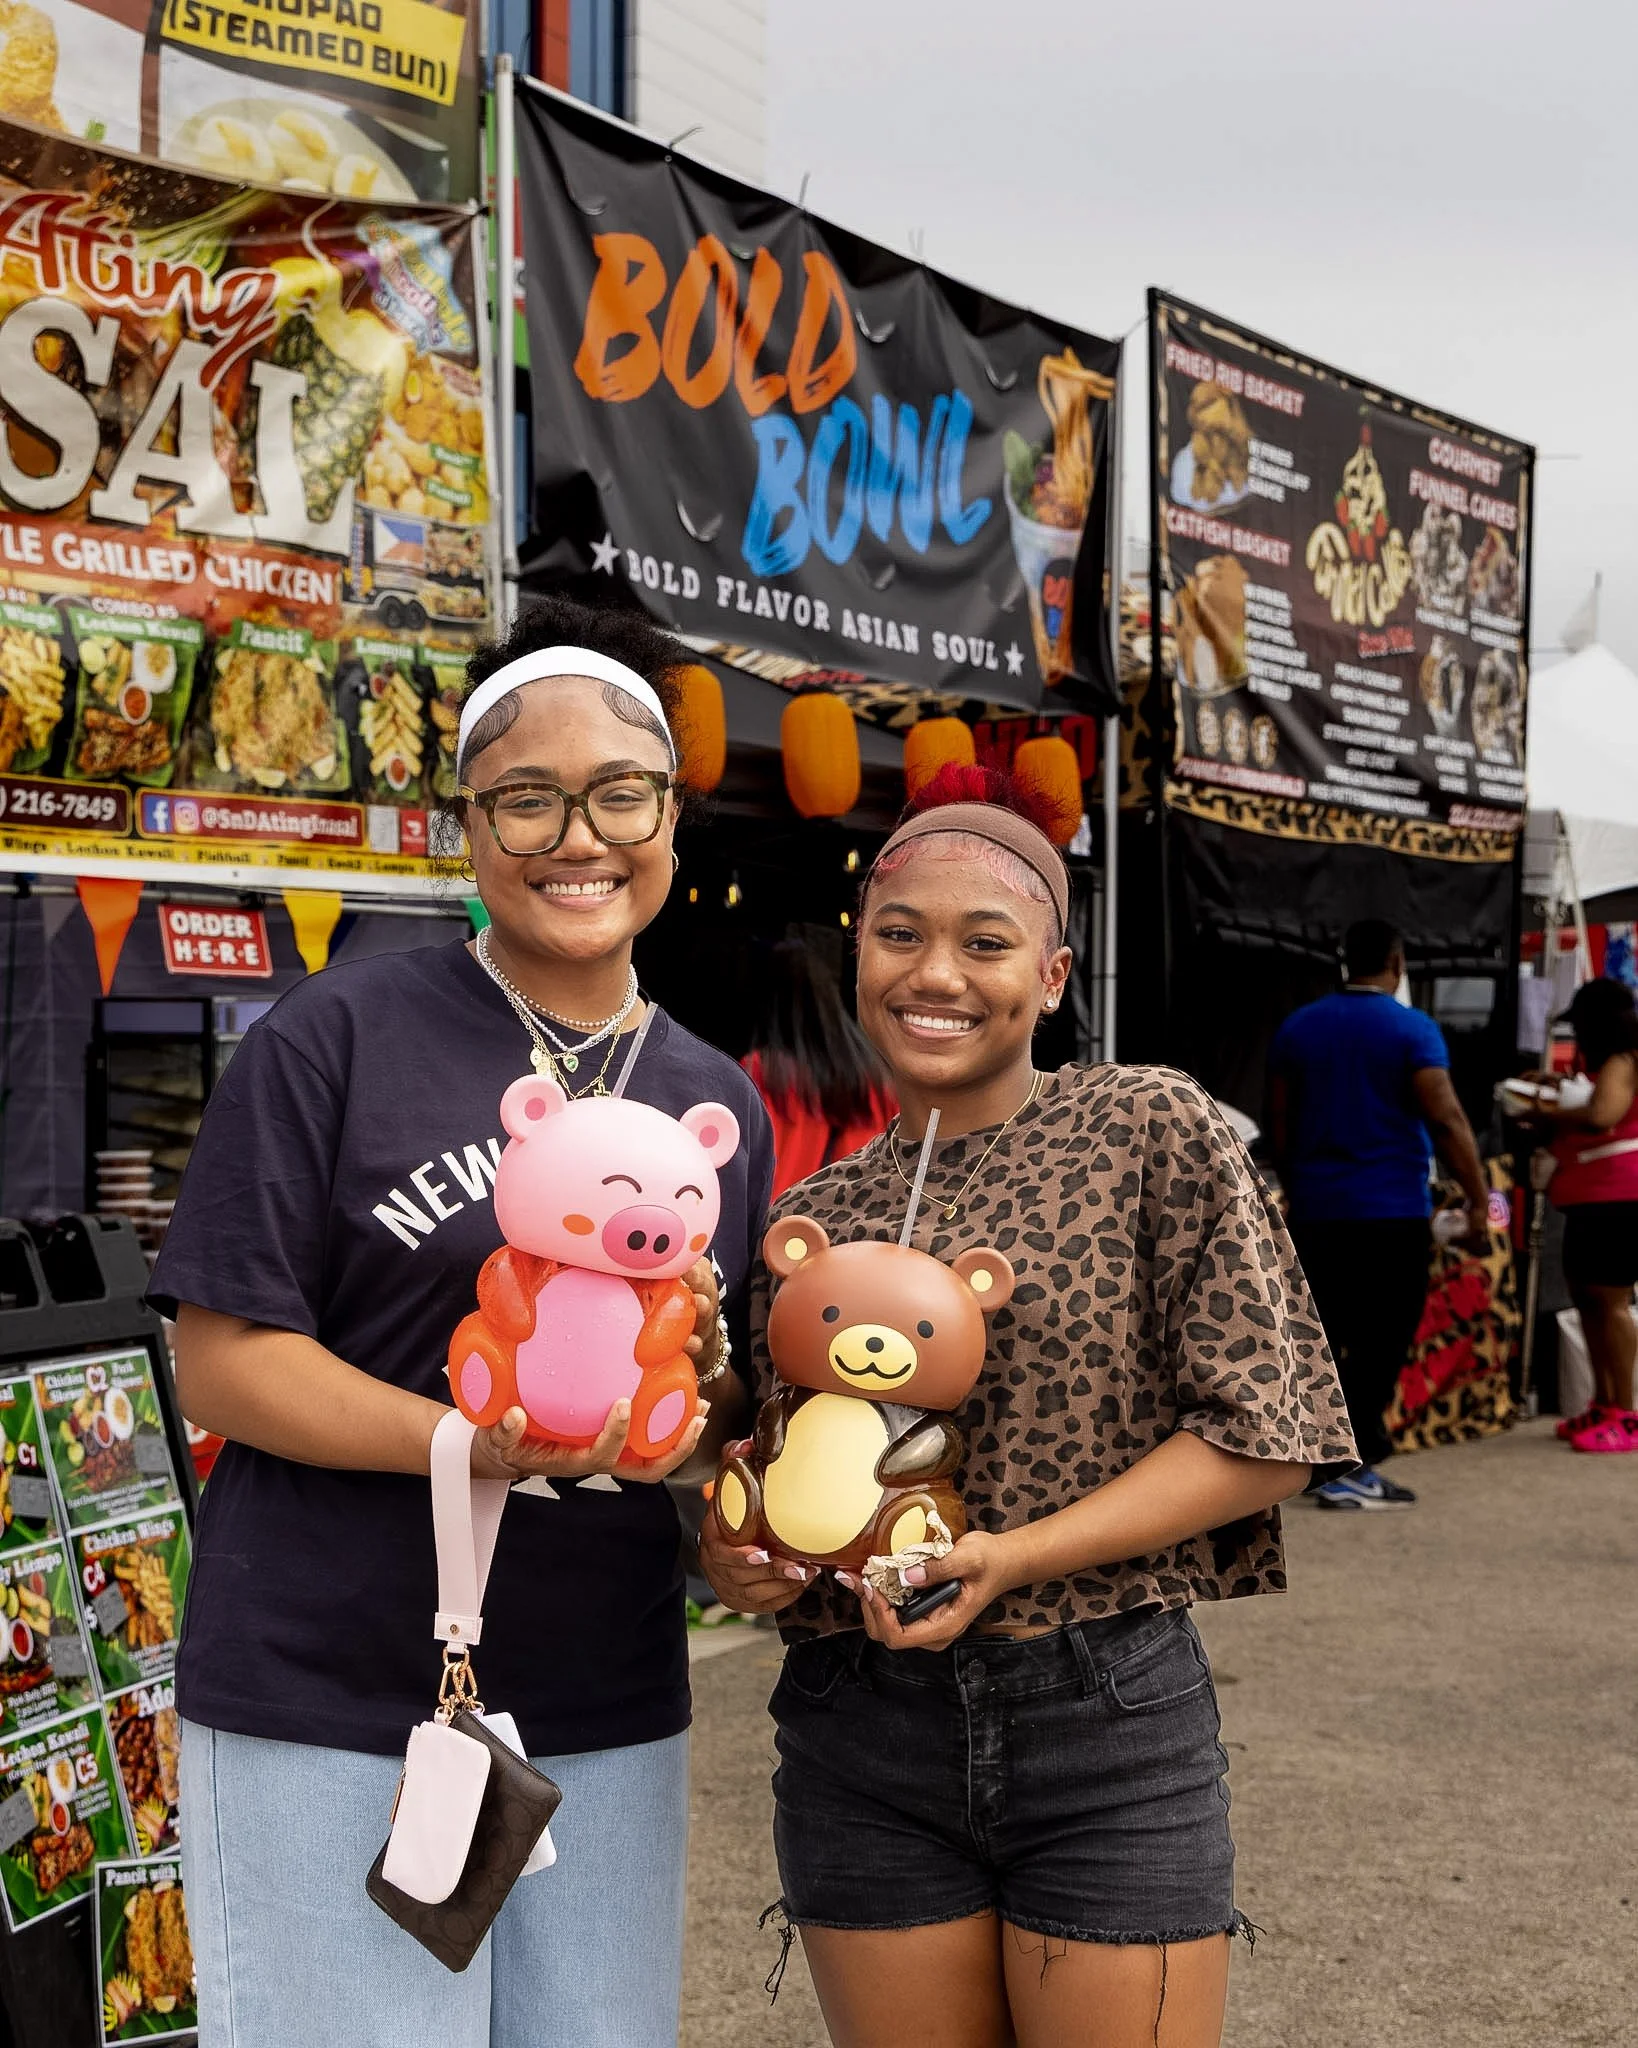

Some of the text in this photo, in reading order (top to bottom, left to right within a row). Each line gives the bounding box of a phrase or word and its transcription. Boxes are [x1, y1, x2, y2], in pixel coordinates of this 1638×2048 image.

[243, 0, 381, 32] OPAO
[573, 232, 856, 417] BOLD
[1429, 437, 1503, 487] GOURMET
[741, 389, 992, 579] BOWL
[53, 531, 197, 585] GRILLED
[204, 551, 336, 605] CHICKEN
[626, 547, 999, 671] BOLD FLAVOR ASIAN SOUL
[240, 622, 303, 653] Pancit
[10, 788, 117, 822] 216-7849
[169, 910, 254, 938] ORDER
[371, 1137, 502, 1251] NEW
[18, 1442, 37, 1467] C1
[84, 1519, 176, 1554] Chicken Wings
[83, 1560, 105, 1592] C4
[139, 1683, 174, 1718] Ado
[76, 1752, 99, 1784] C5
[105, 1867, 147, 1888] Pancit
[148, 1864, 176, 1884] with
